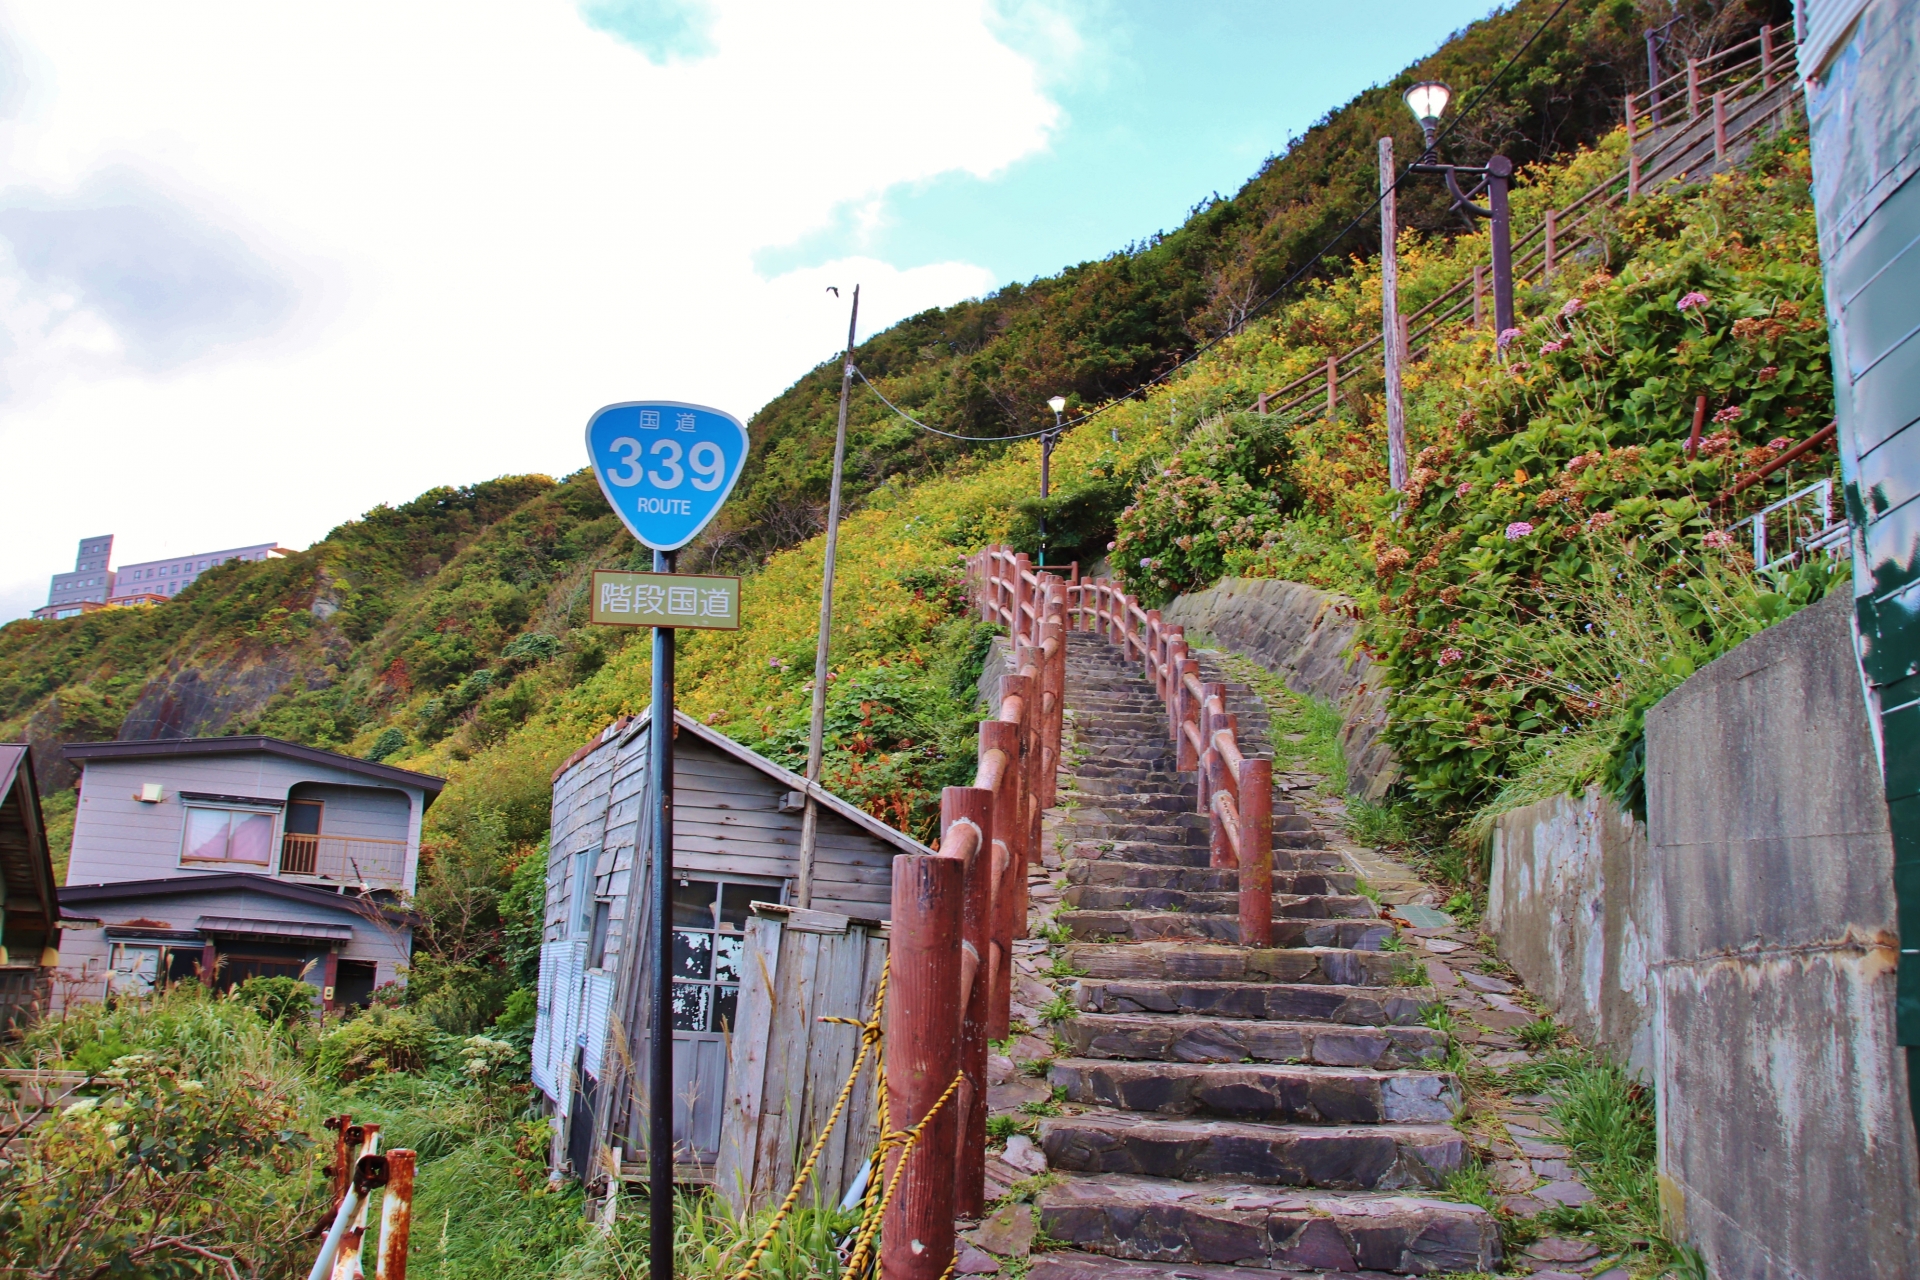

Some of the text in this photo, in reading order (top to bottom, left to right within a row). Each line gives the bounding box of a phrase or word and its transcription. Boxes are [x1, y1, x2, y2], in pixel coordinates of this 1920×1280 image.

[639, 410, 697, 433] 国道
[606, 436, 726, 492] 339
[637, 497, 691, 516] ROUTE
[600, 582, 731, 618] 階段国道
